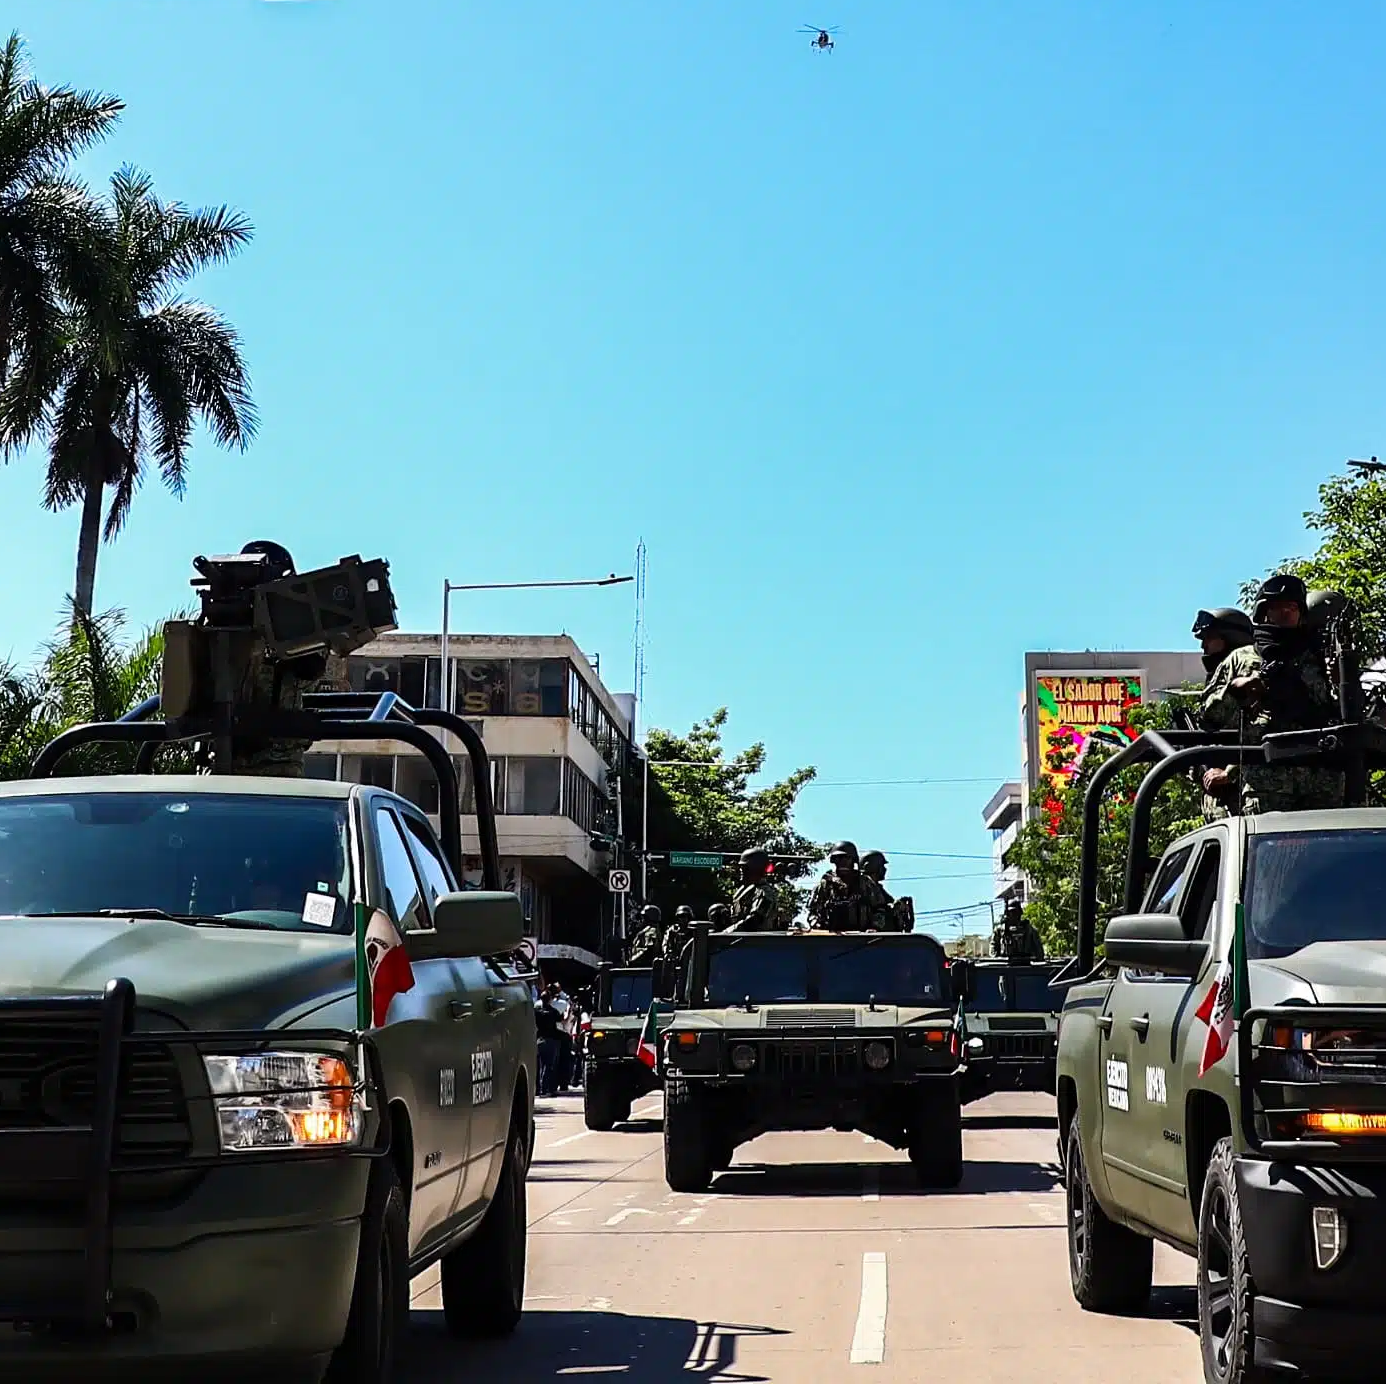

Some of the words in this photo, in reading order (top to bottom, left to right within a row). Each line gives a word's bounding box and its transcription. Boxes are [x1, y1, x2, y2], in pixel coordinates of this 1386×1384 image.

[1067, 682, 1102, 701] SABOR
[1105, 682, 1125, 702] QUE
[1058, 704, 1096, 723] MANDA
